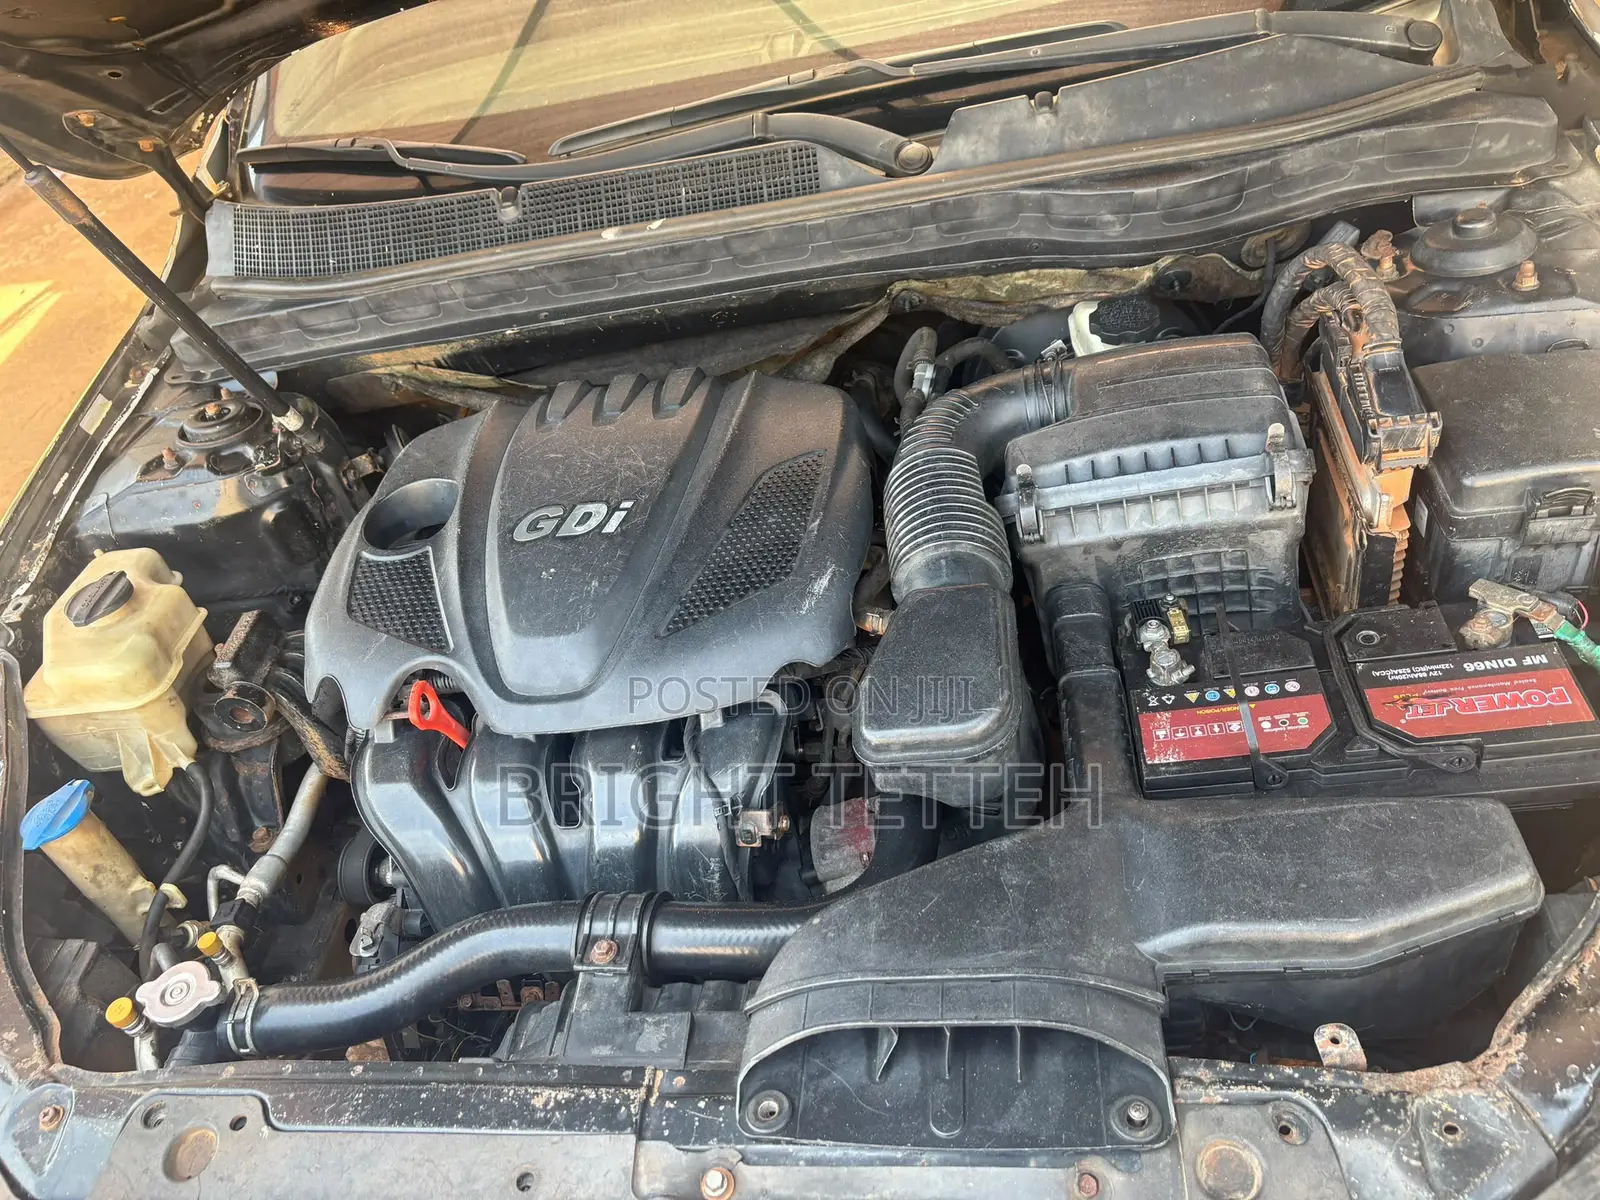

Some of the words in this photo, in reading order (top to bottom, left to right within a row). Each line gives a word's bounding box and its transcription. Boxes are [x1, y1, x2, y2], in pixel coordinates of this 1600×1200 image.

[513, 501, 635, 541] GDi
[1463, 657, 1517, 672] DIN66
[1522, 654, 1548, 666] MF
[1467, 681, 1511, 690] Maintenance
[1513, 678, 1537, 686] Sealed
[1450, 686, 1573, 715] POWER
[1405, 698, 1453, 720] JET
